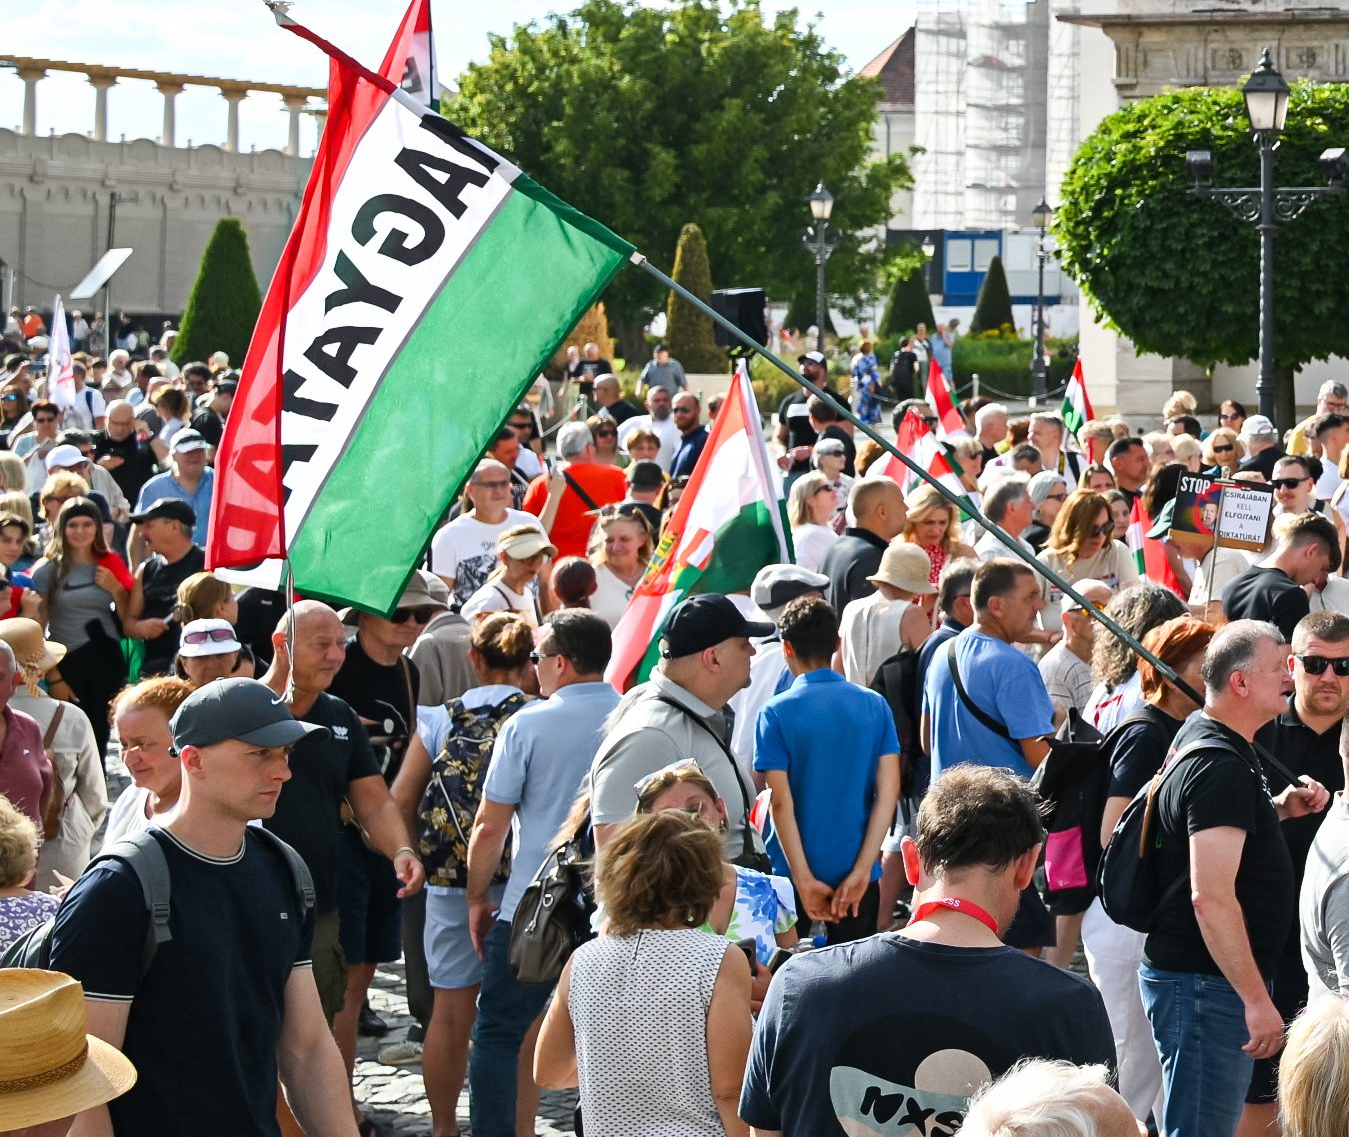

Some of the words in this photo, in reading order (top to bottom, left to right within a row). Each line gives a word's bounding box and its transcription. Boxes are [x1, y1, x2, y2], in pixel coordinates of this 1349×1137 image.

[1180, 476, 1211, 495] STOP
[1236, 503, 1253, 511] KELL
[1224, 511, 1261, 522] ELFOJTANI
